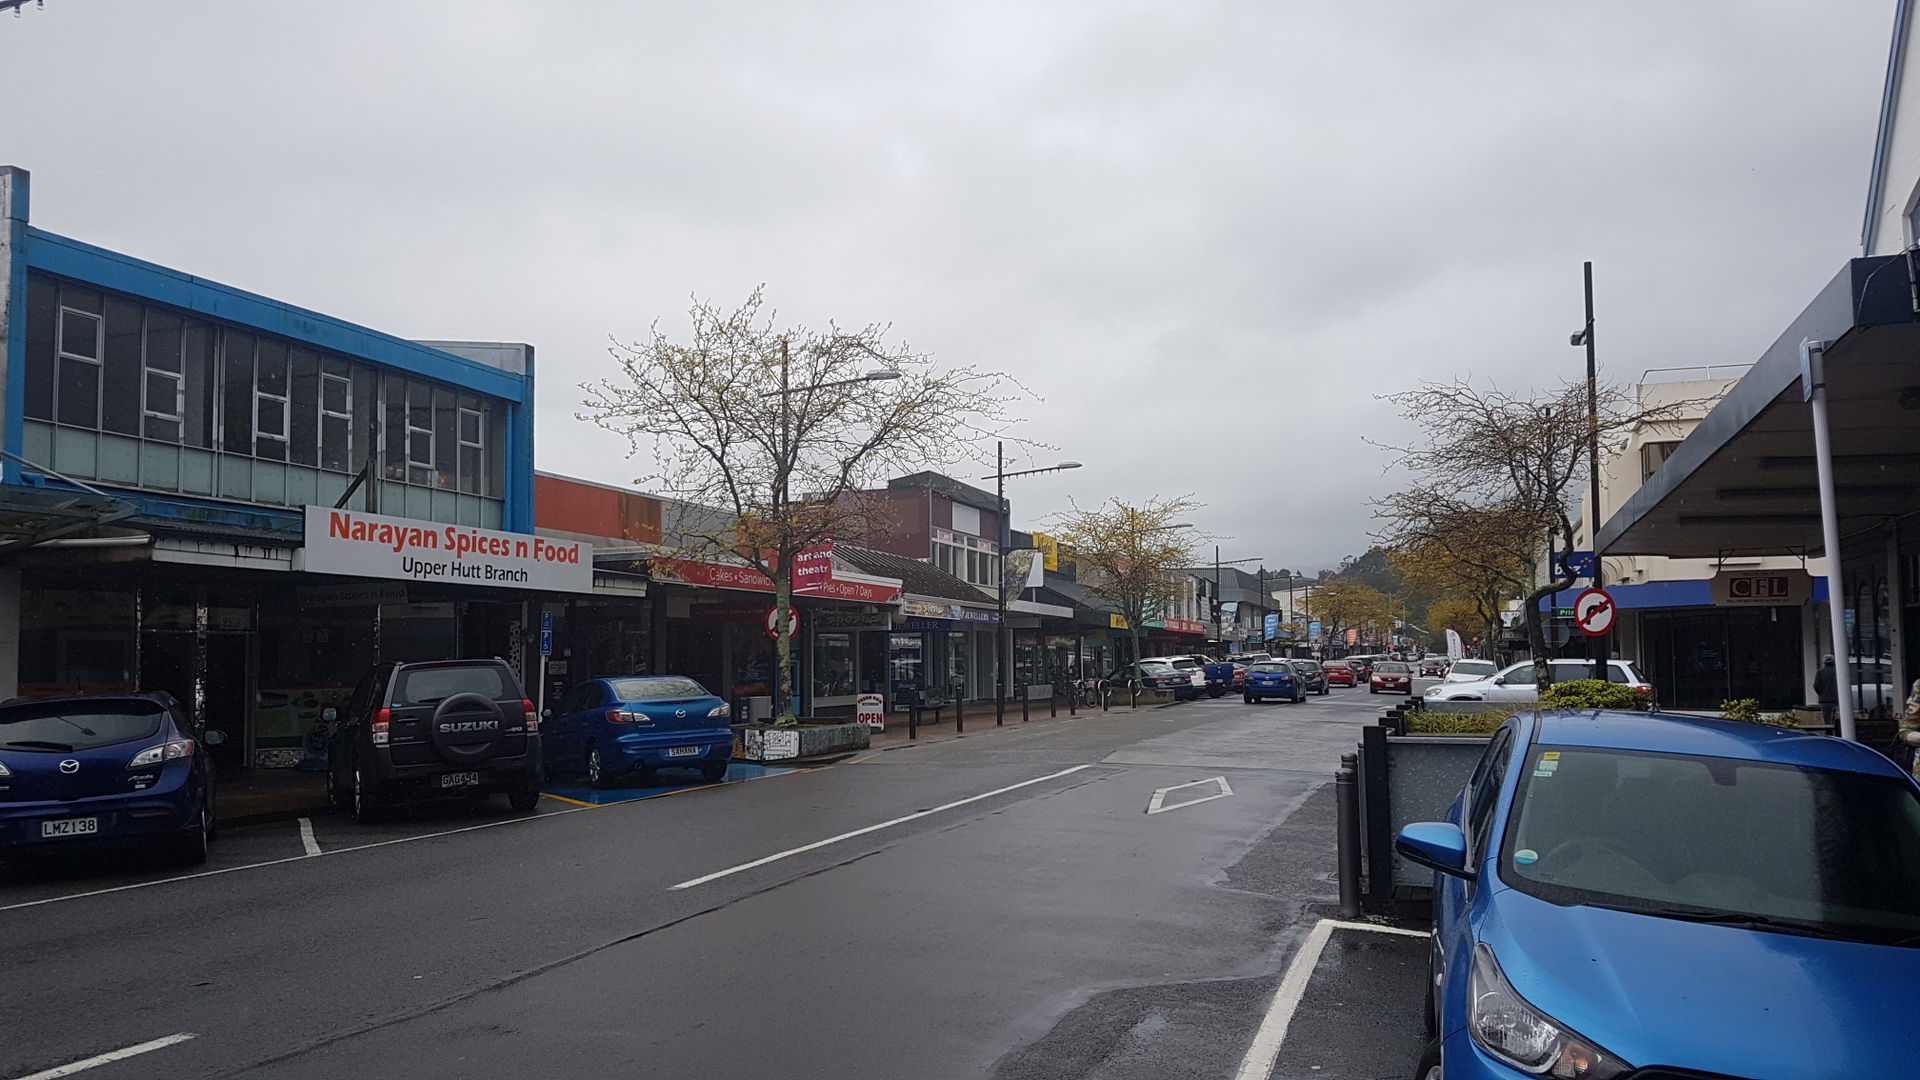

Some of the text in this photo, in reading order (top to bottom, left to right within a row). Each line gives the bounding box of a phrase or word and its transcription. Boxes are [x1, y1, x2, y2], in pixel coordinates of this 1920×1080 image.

[329, 511, 579, 564] Narayan Spices n Food
[797, 550, 832, 562] art and
[402, 557, 528, 582] Upper Hutt Branch
[1555, 563, 1581, 575] bz
[709, 567, 733, 583] Cakes
[823, 581, 836, 592] Pies
[840, 584, 855, 597] Open
[855, 585, 859, 595] 7
[860, 586, 873, 598] Days
[1731, 578, 1786, 596] CFL
[381, 589, 405, 599] Food
[858, 713, 882, 724] OPEN
[440, 720, 499, 733] SUZUKI
[671, 747, 696, 756] SAHANA
[442, 773, 478, 785] GAG454
[44, 820, 96, 835] LMZ138
